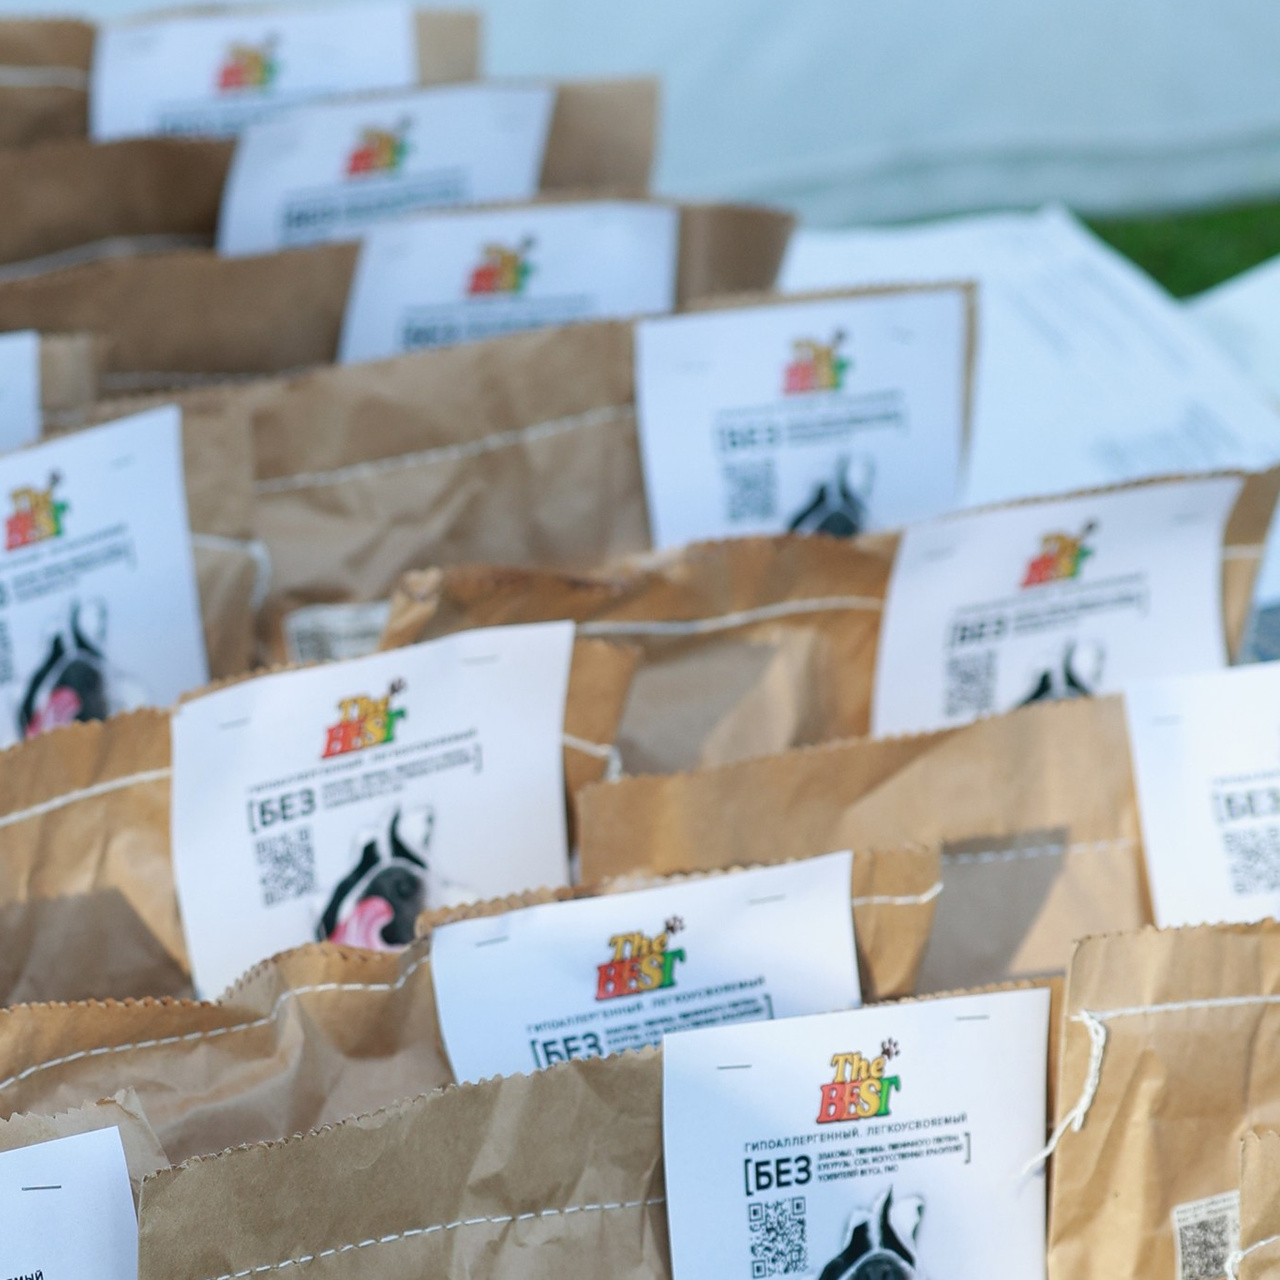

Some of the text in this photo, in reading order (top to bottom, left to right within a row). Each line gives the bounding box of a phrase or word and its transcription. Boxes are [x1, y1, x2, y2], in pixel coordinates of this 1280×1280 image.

[608, 930, 670, 963] The
[594, 946, 687, 1002] BEST
[831, 1051, 886, 1084] The
[816, 1075, 901, 1124] BEST
